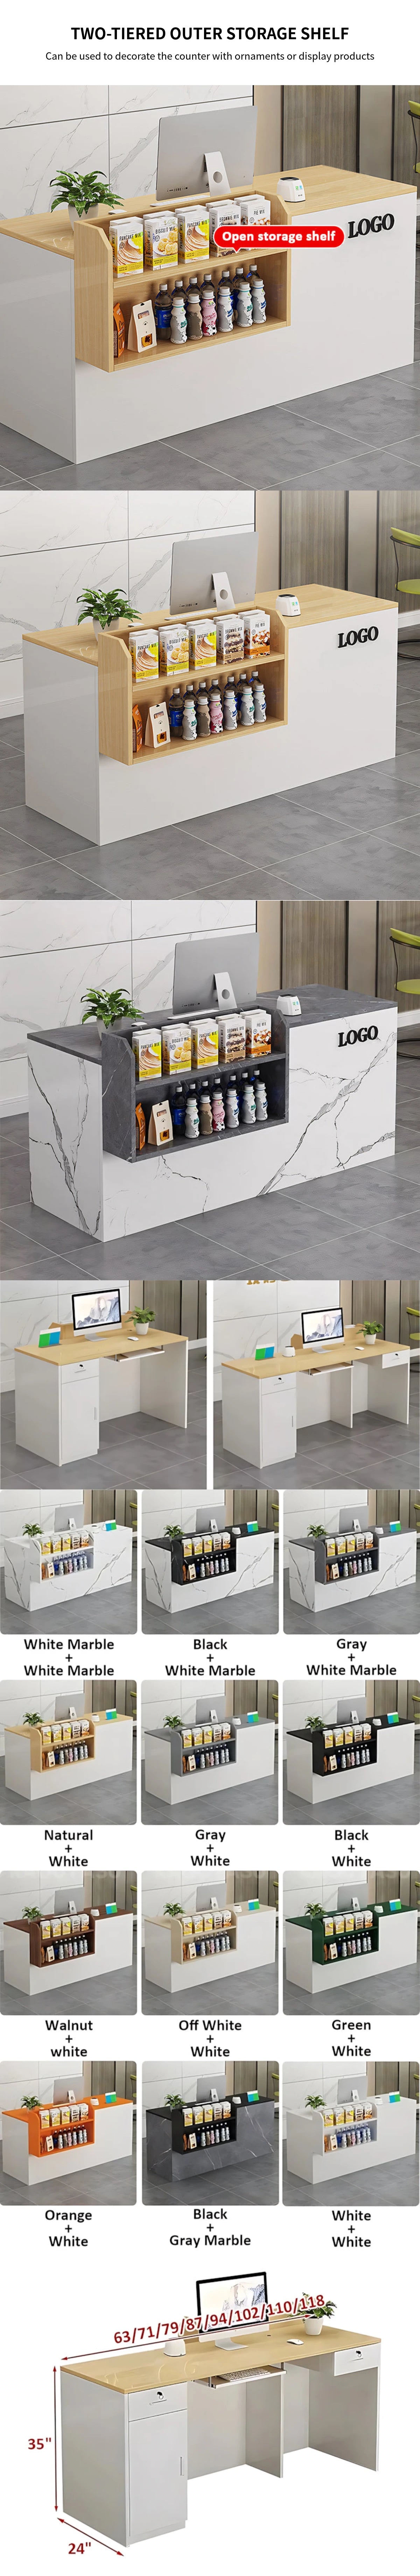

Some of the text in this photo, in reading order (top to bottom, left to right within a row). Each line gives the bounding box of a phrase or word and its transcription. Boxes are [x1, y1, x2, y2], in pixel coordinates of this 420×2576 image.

[348, 213, 394, 239] LOGO
[337, 626, 379, 648] LOGO
[338, 1026, 378, 1047] LOGO
